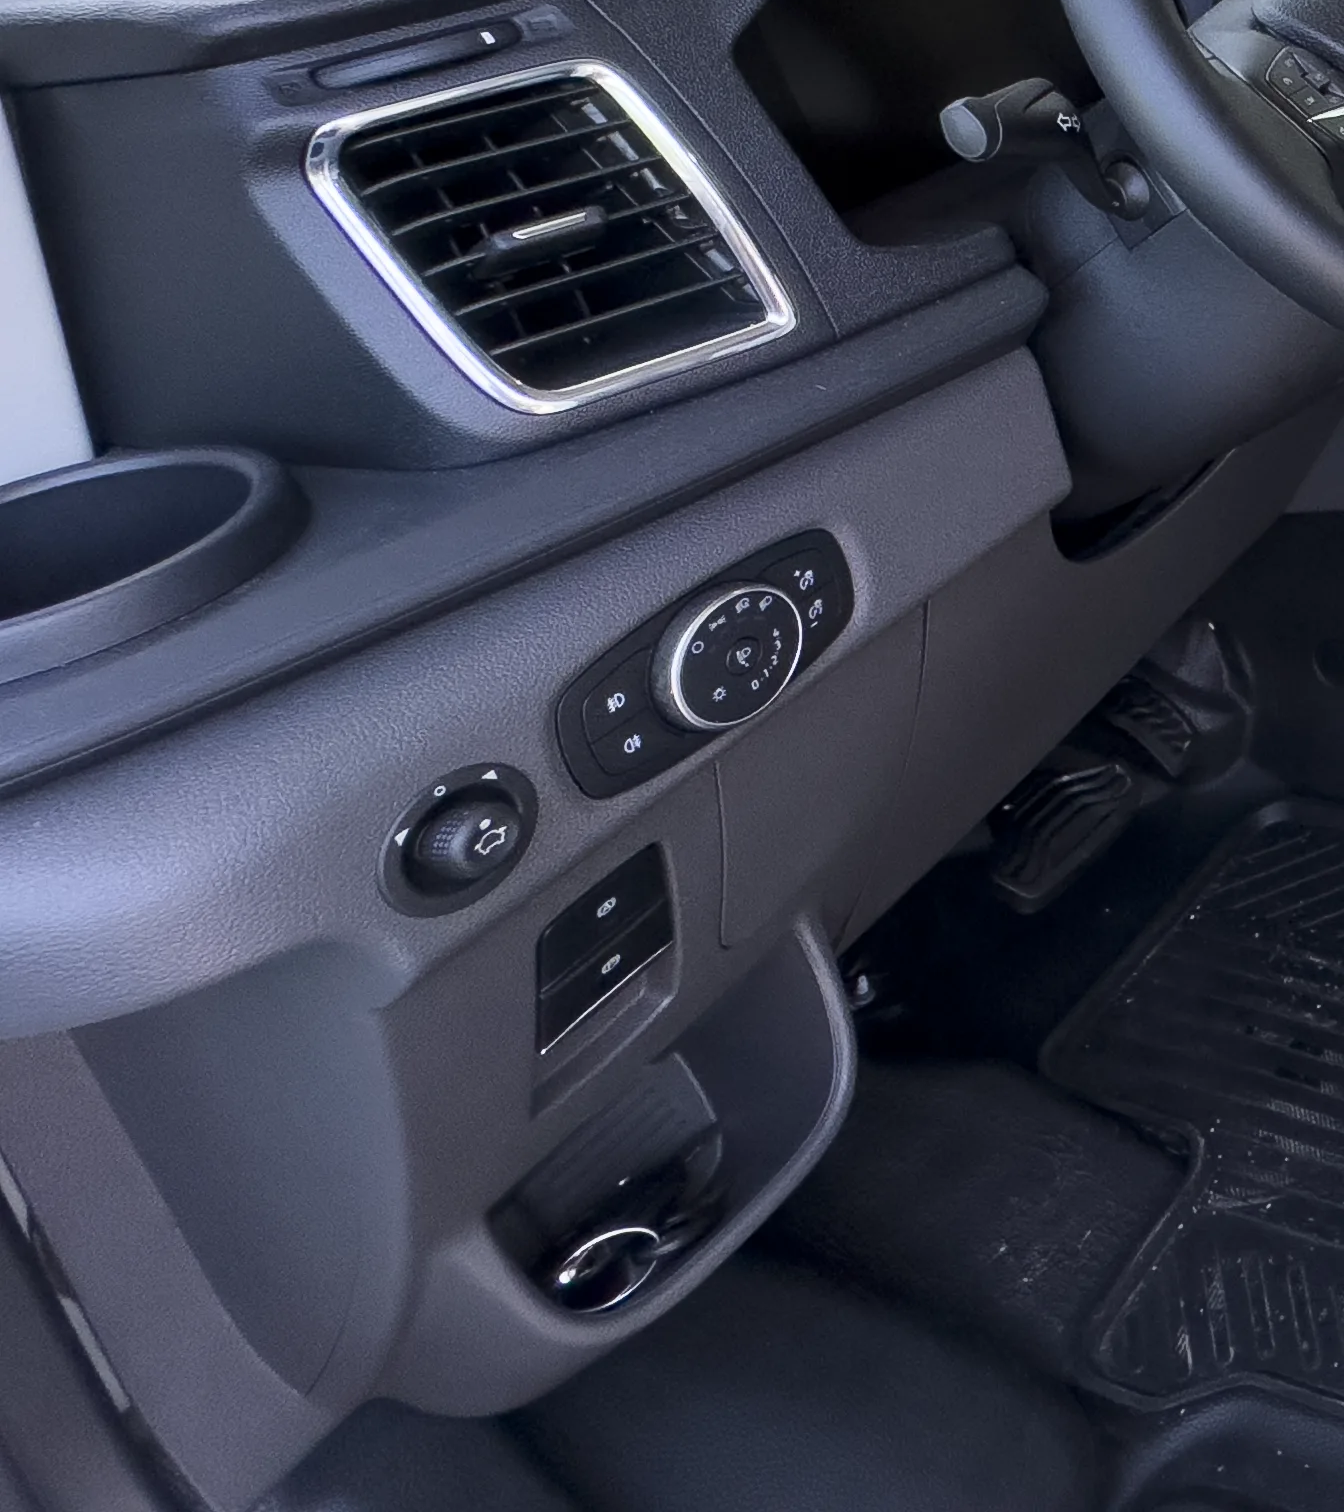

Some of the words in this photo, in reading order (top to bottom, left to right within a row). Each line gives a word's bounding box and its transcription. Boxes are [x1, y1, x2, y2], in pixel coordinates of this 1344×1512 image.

[773, 639, 782, 651] 3
[771, 654, 779, 666] 2
[751, 679, 760, 691] 0
